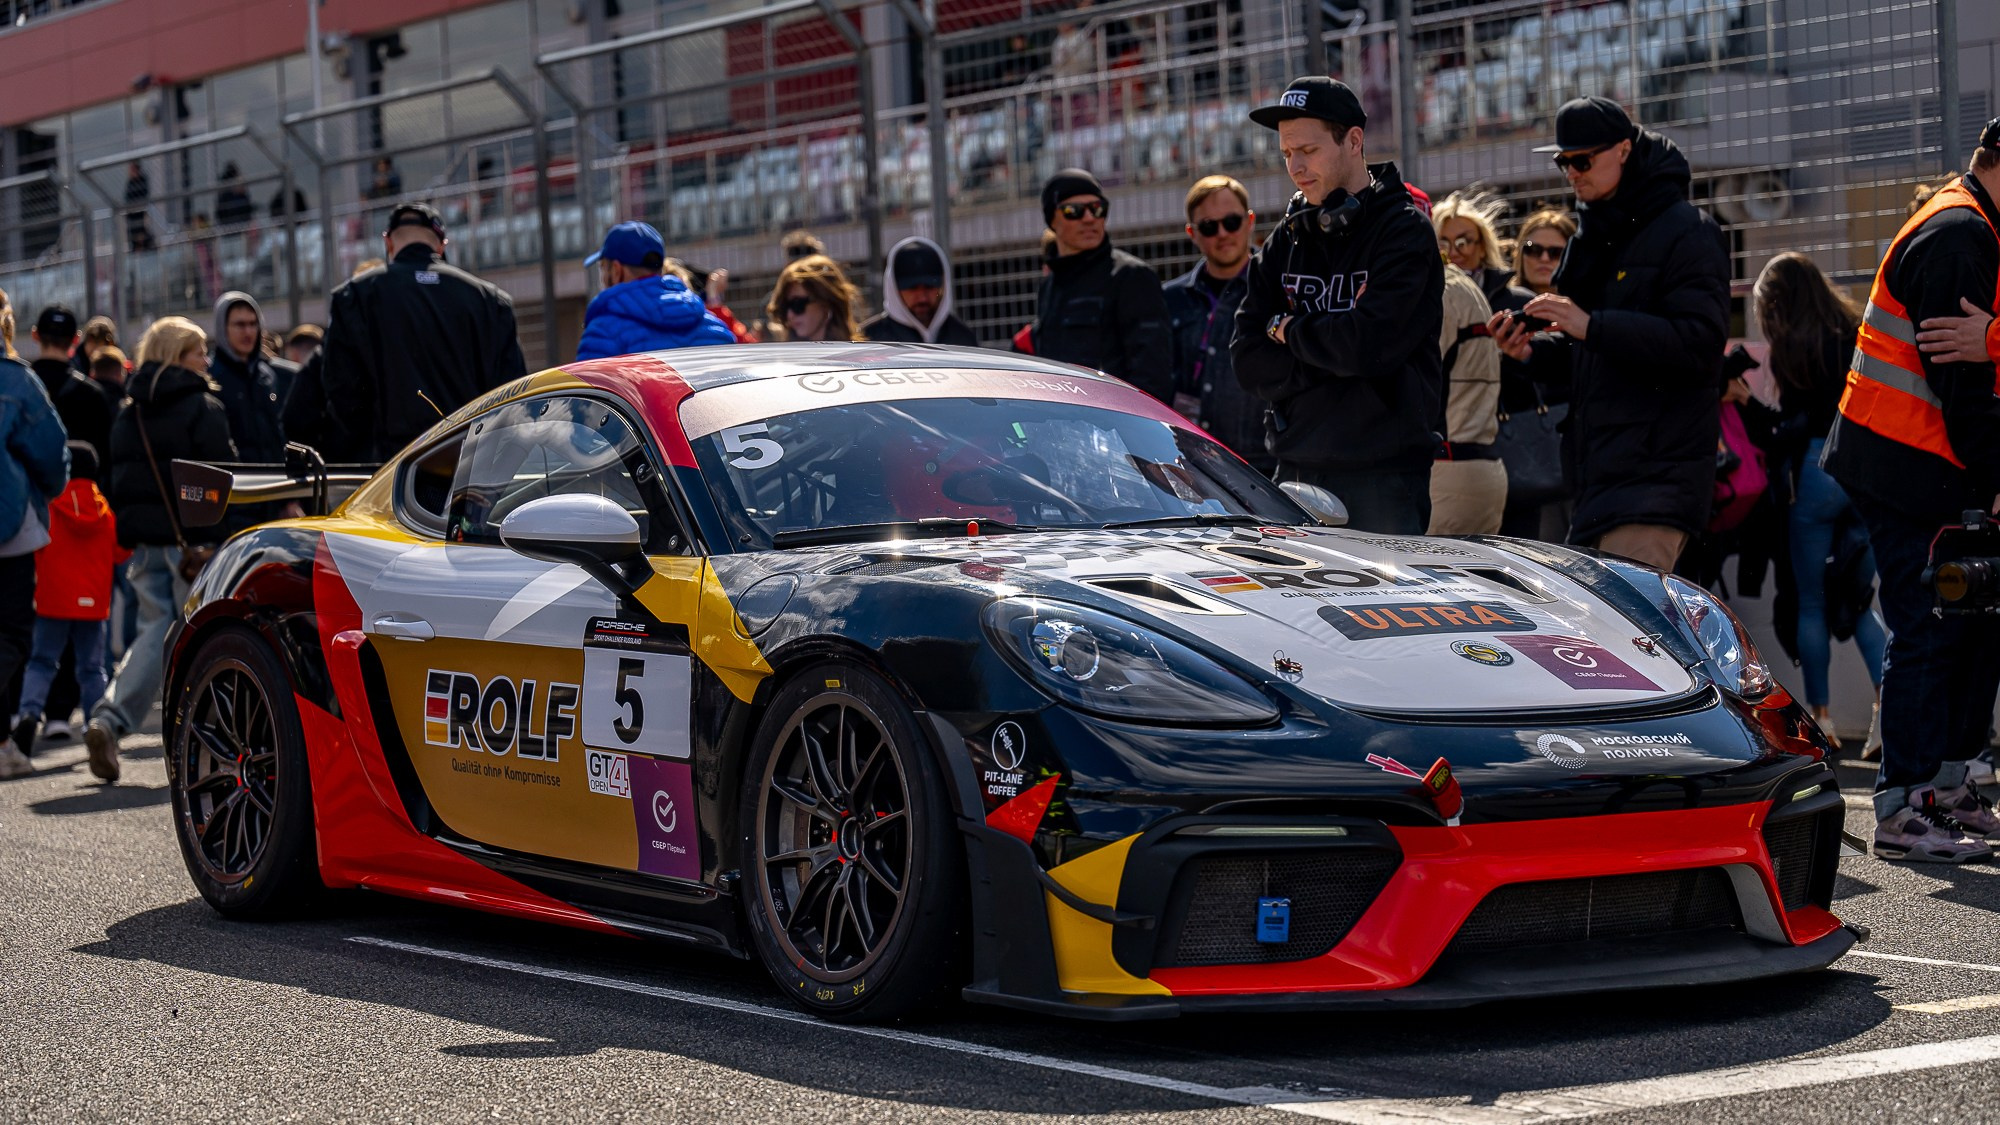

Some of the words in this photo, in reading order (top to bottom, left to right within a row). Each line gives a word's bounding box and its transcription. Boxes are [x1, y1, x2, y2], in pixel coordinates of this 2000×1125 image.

[1297, 271, 1368, 313] RLF
[852, 371, 949, 386] СБЕР
[957, 372, 1088, 396] Првый
[719, 422, 784, 470] 5
[1254, 564, 1468, 589] ROLF
[595, 620, 646, 632] PORSCHE
[1345, 604, 1515, 630] ULTRA
[593, 634, 605, 642] SPORT
[612, 657, 646, 745] 5
[449, 672, 580, 762] ROLF
[452, 758, 483, 776] Qualität
[483, 763, 502, 778] ohne
[504, 766, 561, 787] Kompromisse
[984, 771, 1024, 785] PIT-LANE
[590, 779, 609, 792] OPEN
[987, 785, 1017, 797] COFFEE
[652, 840, 667, 850] СБЕР
[667, 843, 687, 855] Первый
[853, 977, 865, 996] FR
